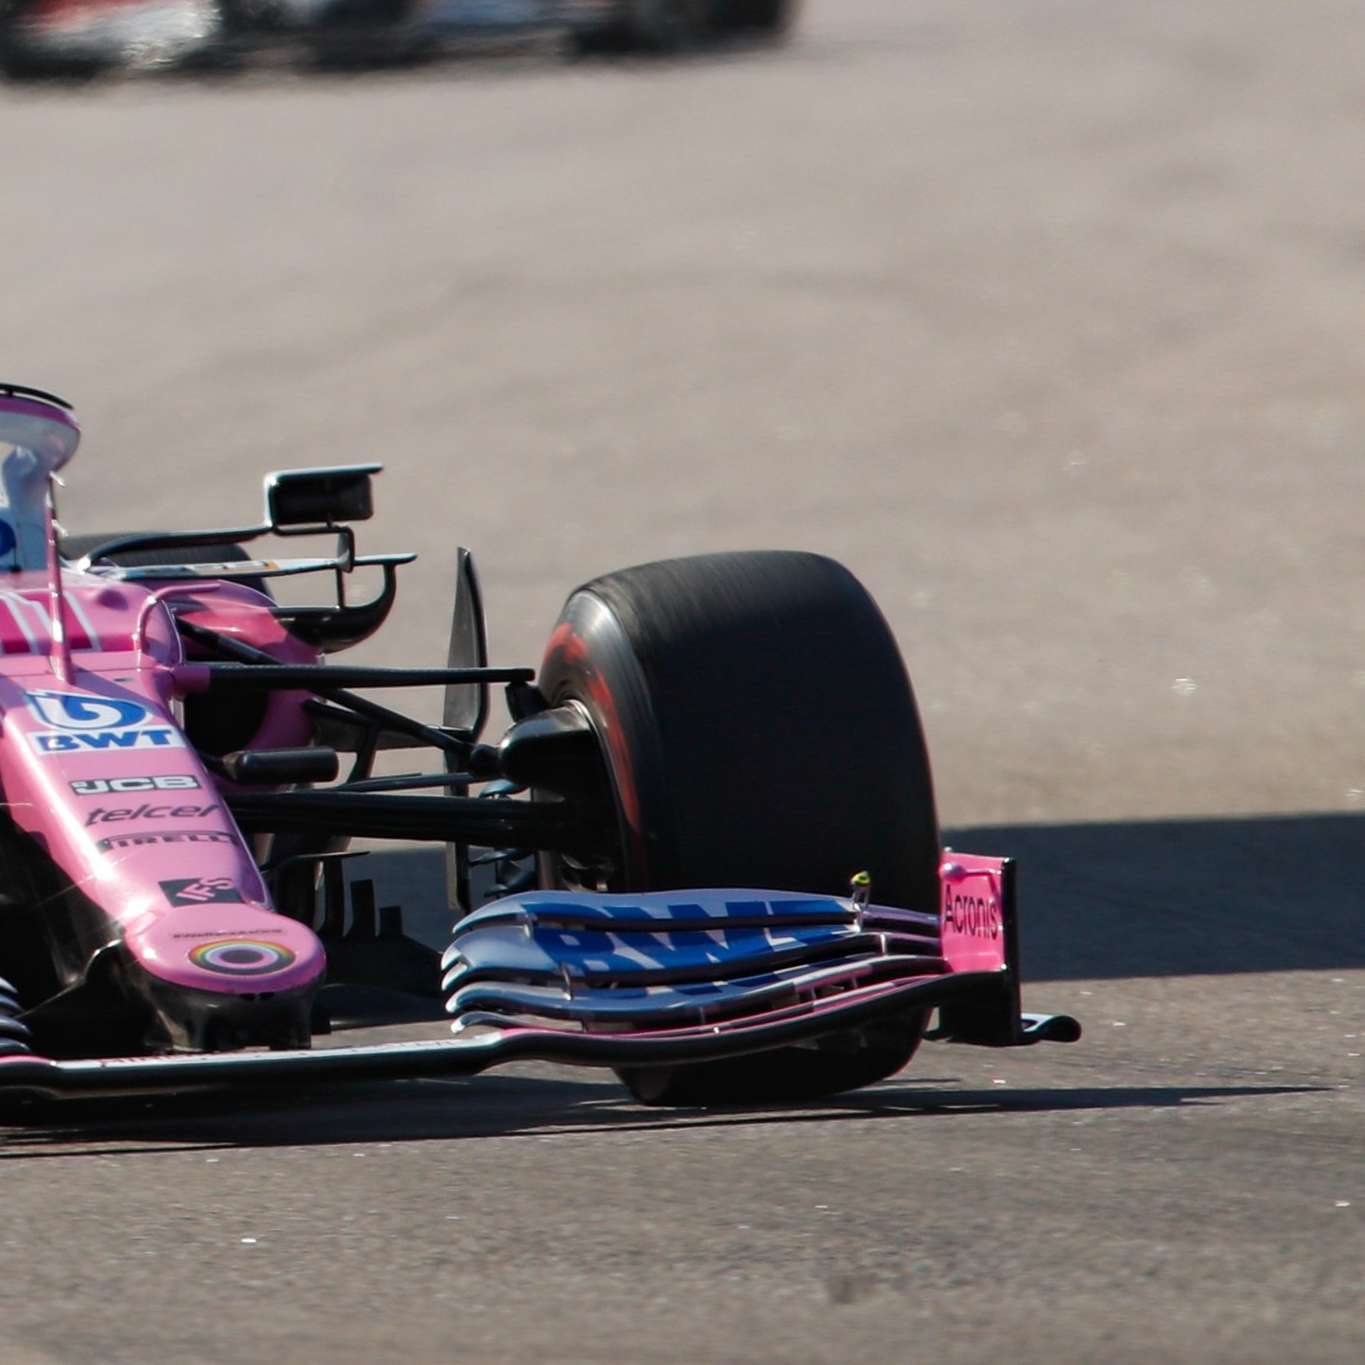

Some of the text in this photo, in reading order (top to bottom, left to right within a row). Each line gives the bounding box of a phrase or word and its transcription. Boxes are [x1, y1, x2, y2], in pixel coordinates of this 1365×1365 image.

[35, 729, 173, 751] BWT
[71, 776, 199, 795] JCB
[175, 877, 235, 902] IFS
[944, 883, 999, 941] Acronis
